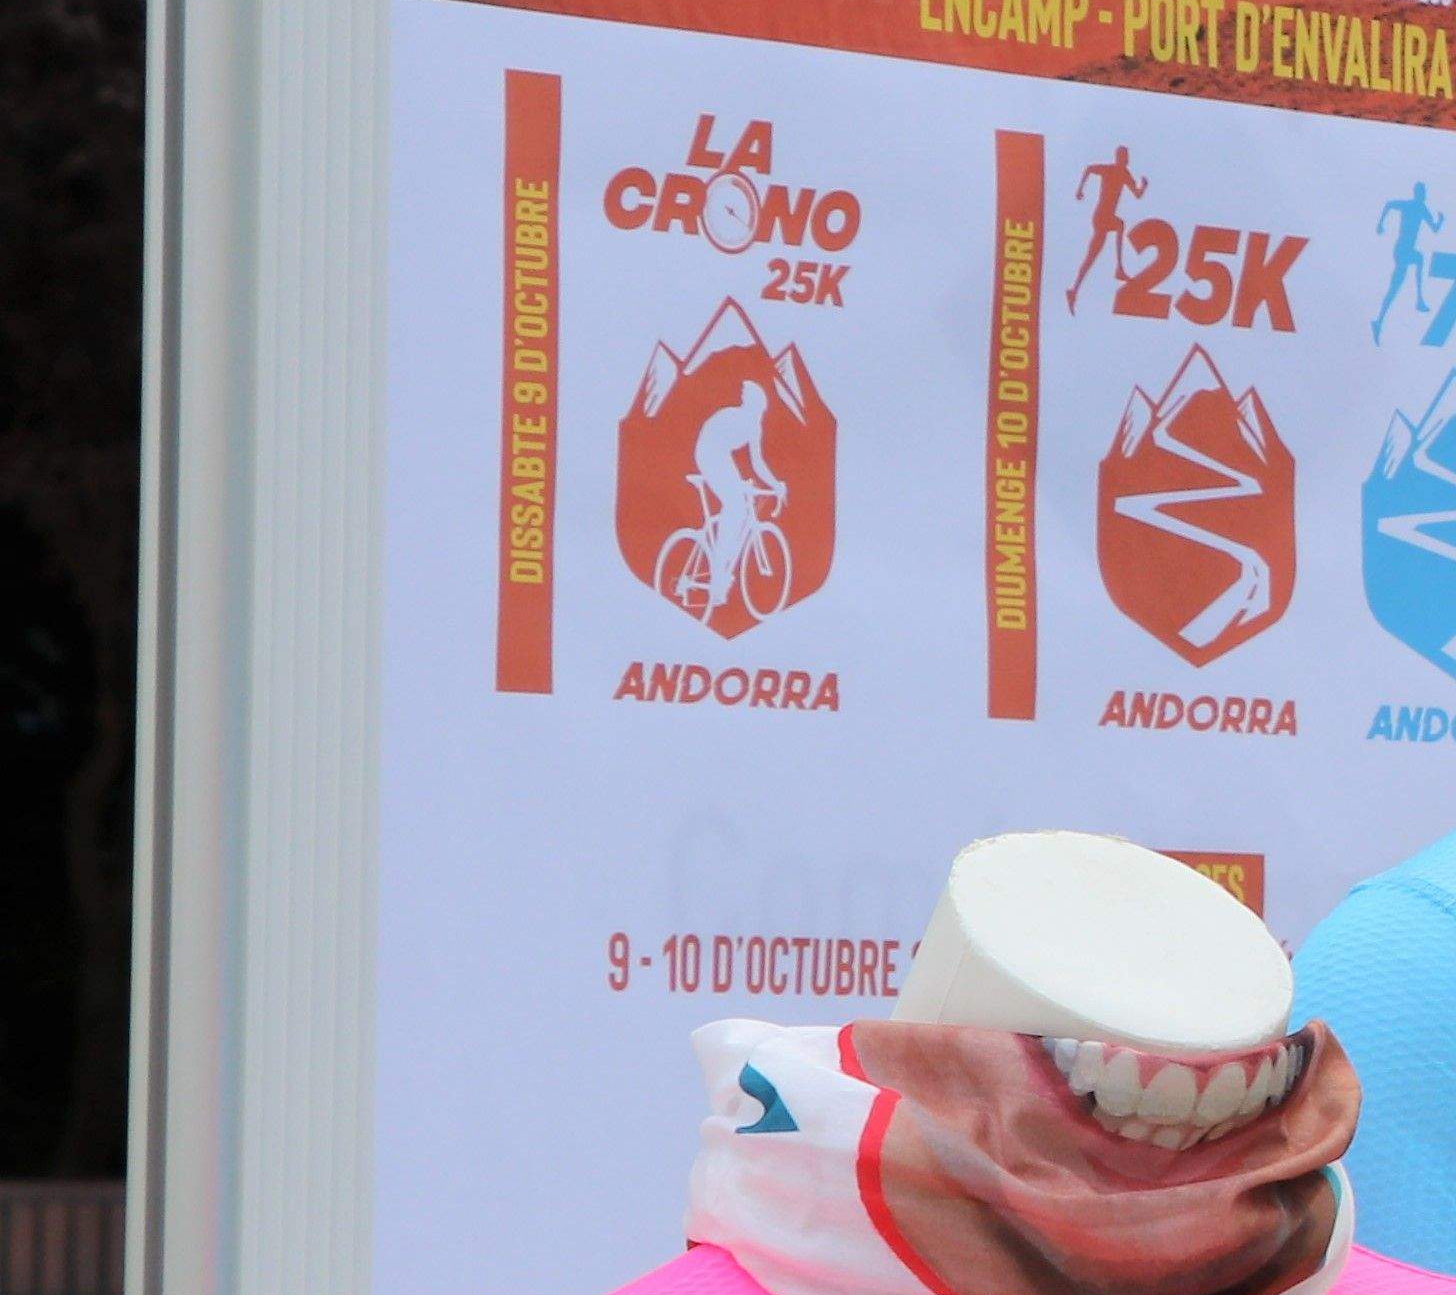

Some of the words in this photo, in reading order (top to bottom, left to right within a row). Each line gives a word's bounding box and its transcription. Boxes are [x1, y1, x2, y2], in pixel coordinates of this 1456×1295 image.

[1236, 1, 1453, 100] D'ENVALIRA
[686, 113, 774, 174] LA
[603, 167, 861, 254] CRONO
[513, 178, 549, 373] D'OCTUBRE
[761, 258, 852, 307] 25K
[999, 219, 1035, 402] D'OCTUBRE
[1112, 218, 1310, 333] 25K
[514, 381, 547, 404] 9
[997, 412, 1029, 449] 10
[509, 414, 547, 583] DISSABTE
[995, 459, 1027, 630] DIUMENGE
[613, 662, 839, 712] ANDORRA
[1099, 691, 1297, 737] ANDORRA
[608, 932, 630, 992] 9
[663, 934, 701, 993] 10
[712, 935, 900, 997] D'OCTUBRE
